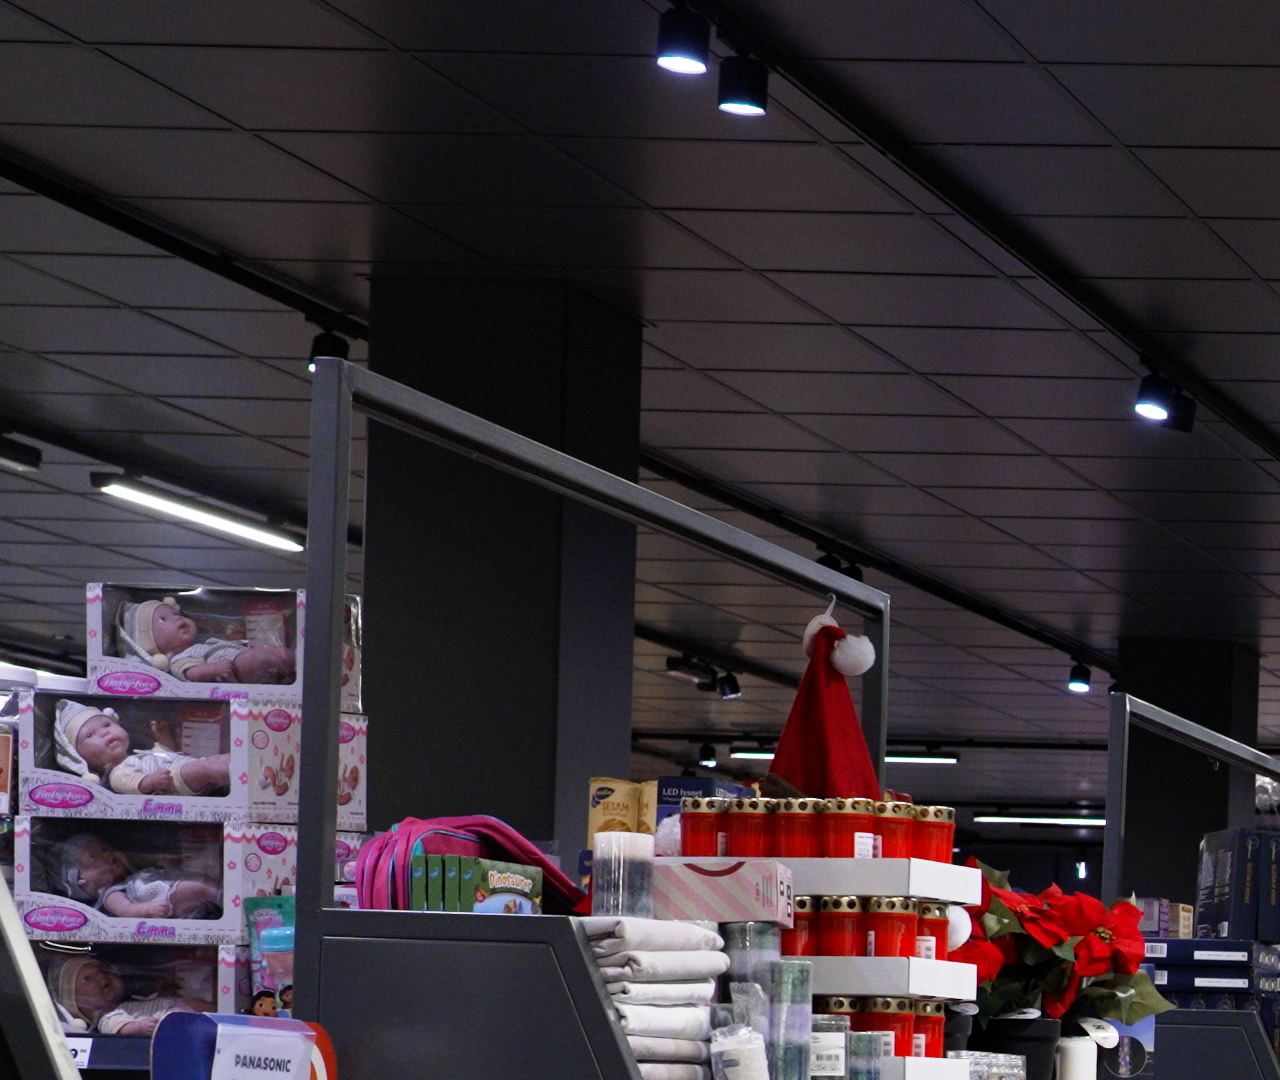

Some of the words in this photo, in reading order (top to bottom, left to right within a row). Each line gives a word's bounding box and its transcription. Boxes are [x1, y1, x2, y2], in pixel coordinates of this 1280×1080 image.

[662, 787, 679, 796] LED
[487, 870, 533, 893] Dinosaurer
[234, 1054, 292, 1073] PANASONIC
